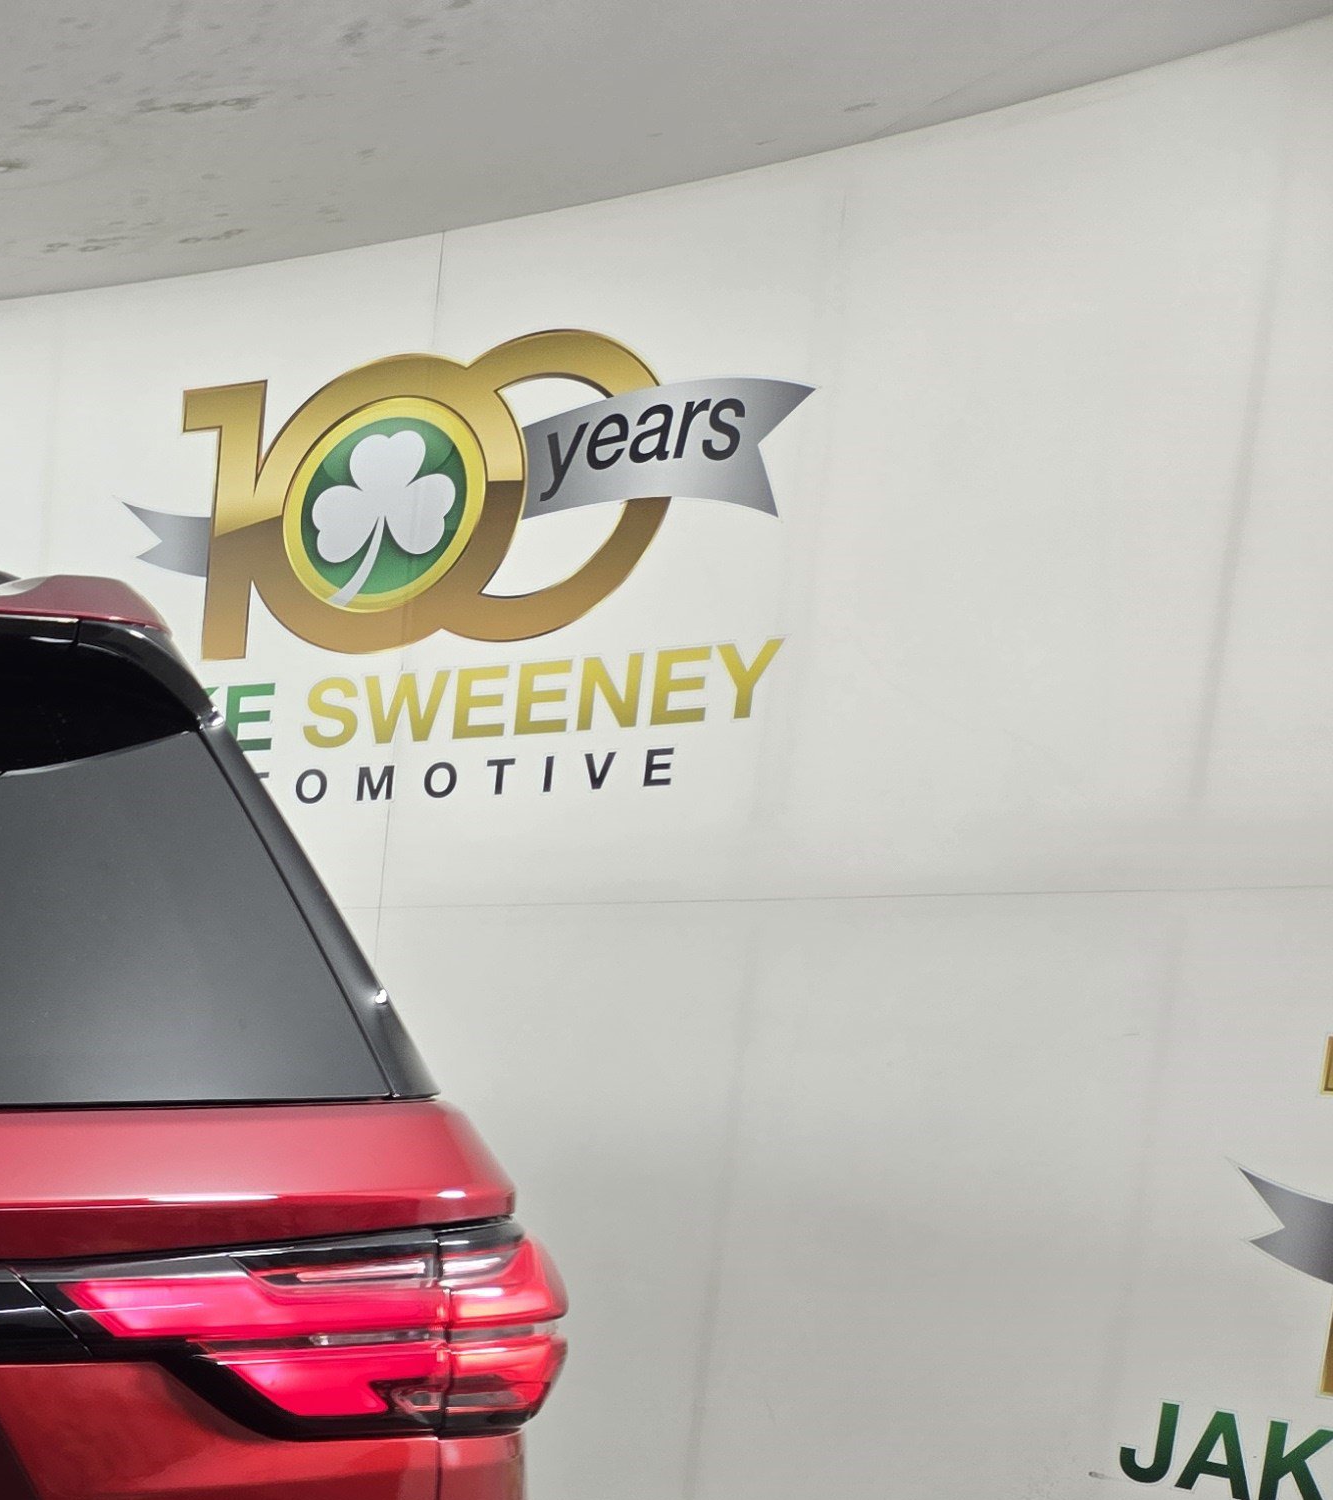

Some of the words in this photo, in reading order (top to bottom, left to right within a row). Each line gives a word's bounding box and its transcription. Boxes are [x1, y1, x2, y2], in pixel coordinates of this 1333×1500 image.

[183, 329, 672, 660] 100
[541, 397, 746, 502] years
[303, 637, 786, 749] SWEENEY
[255, 747, 675, 804] OMOTIVE
